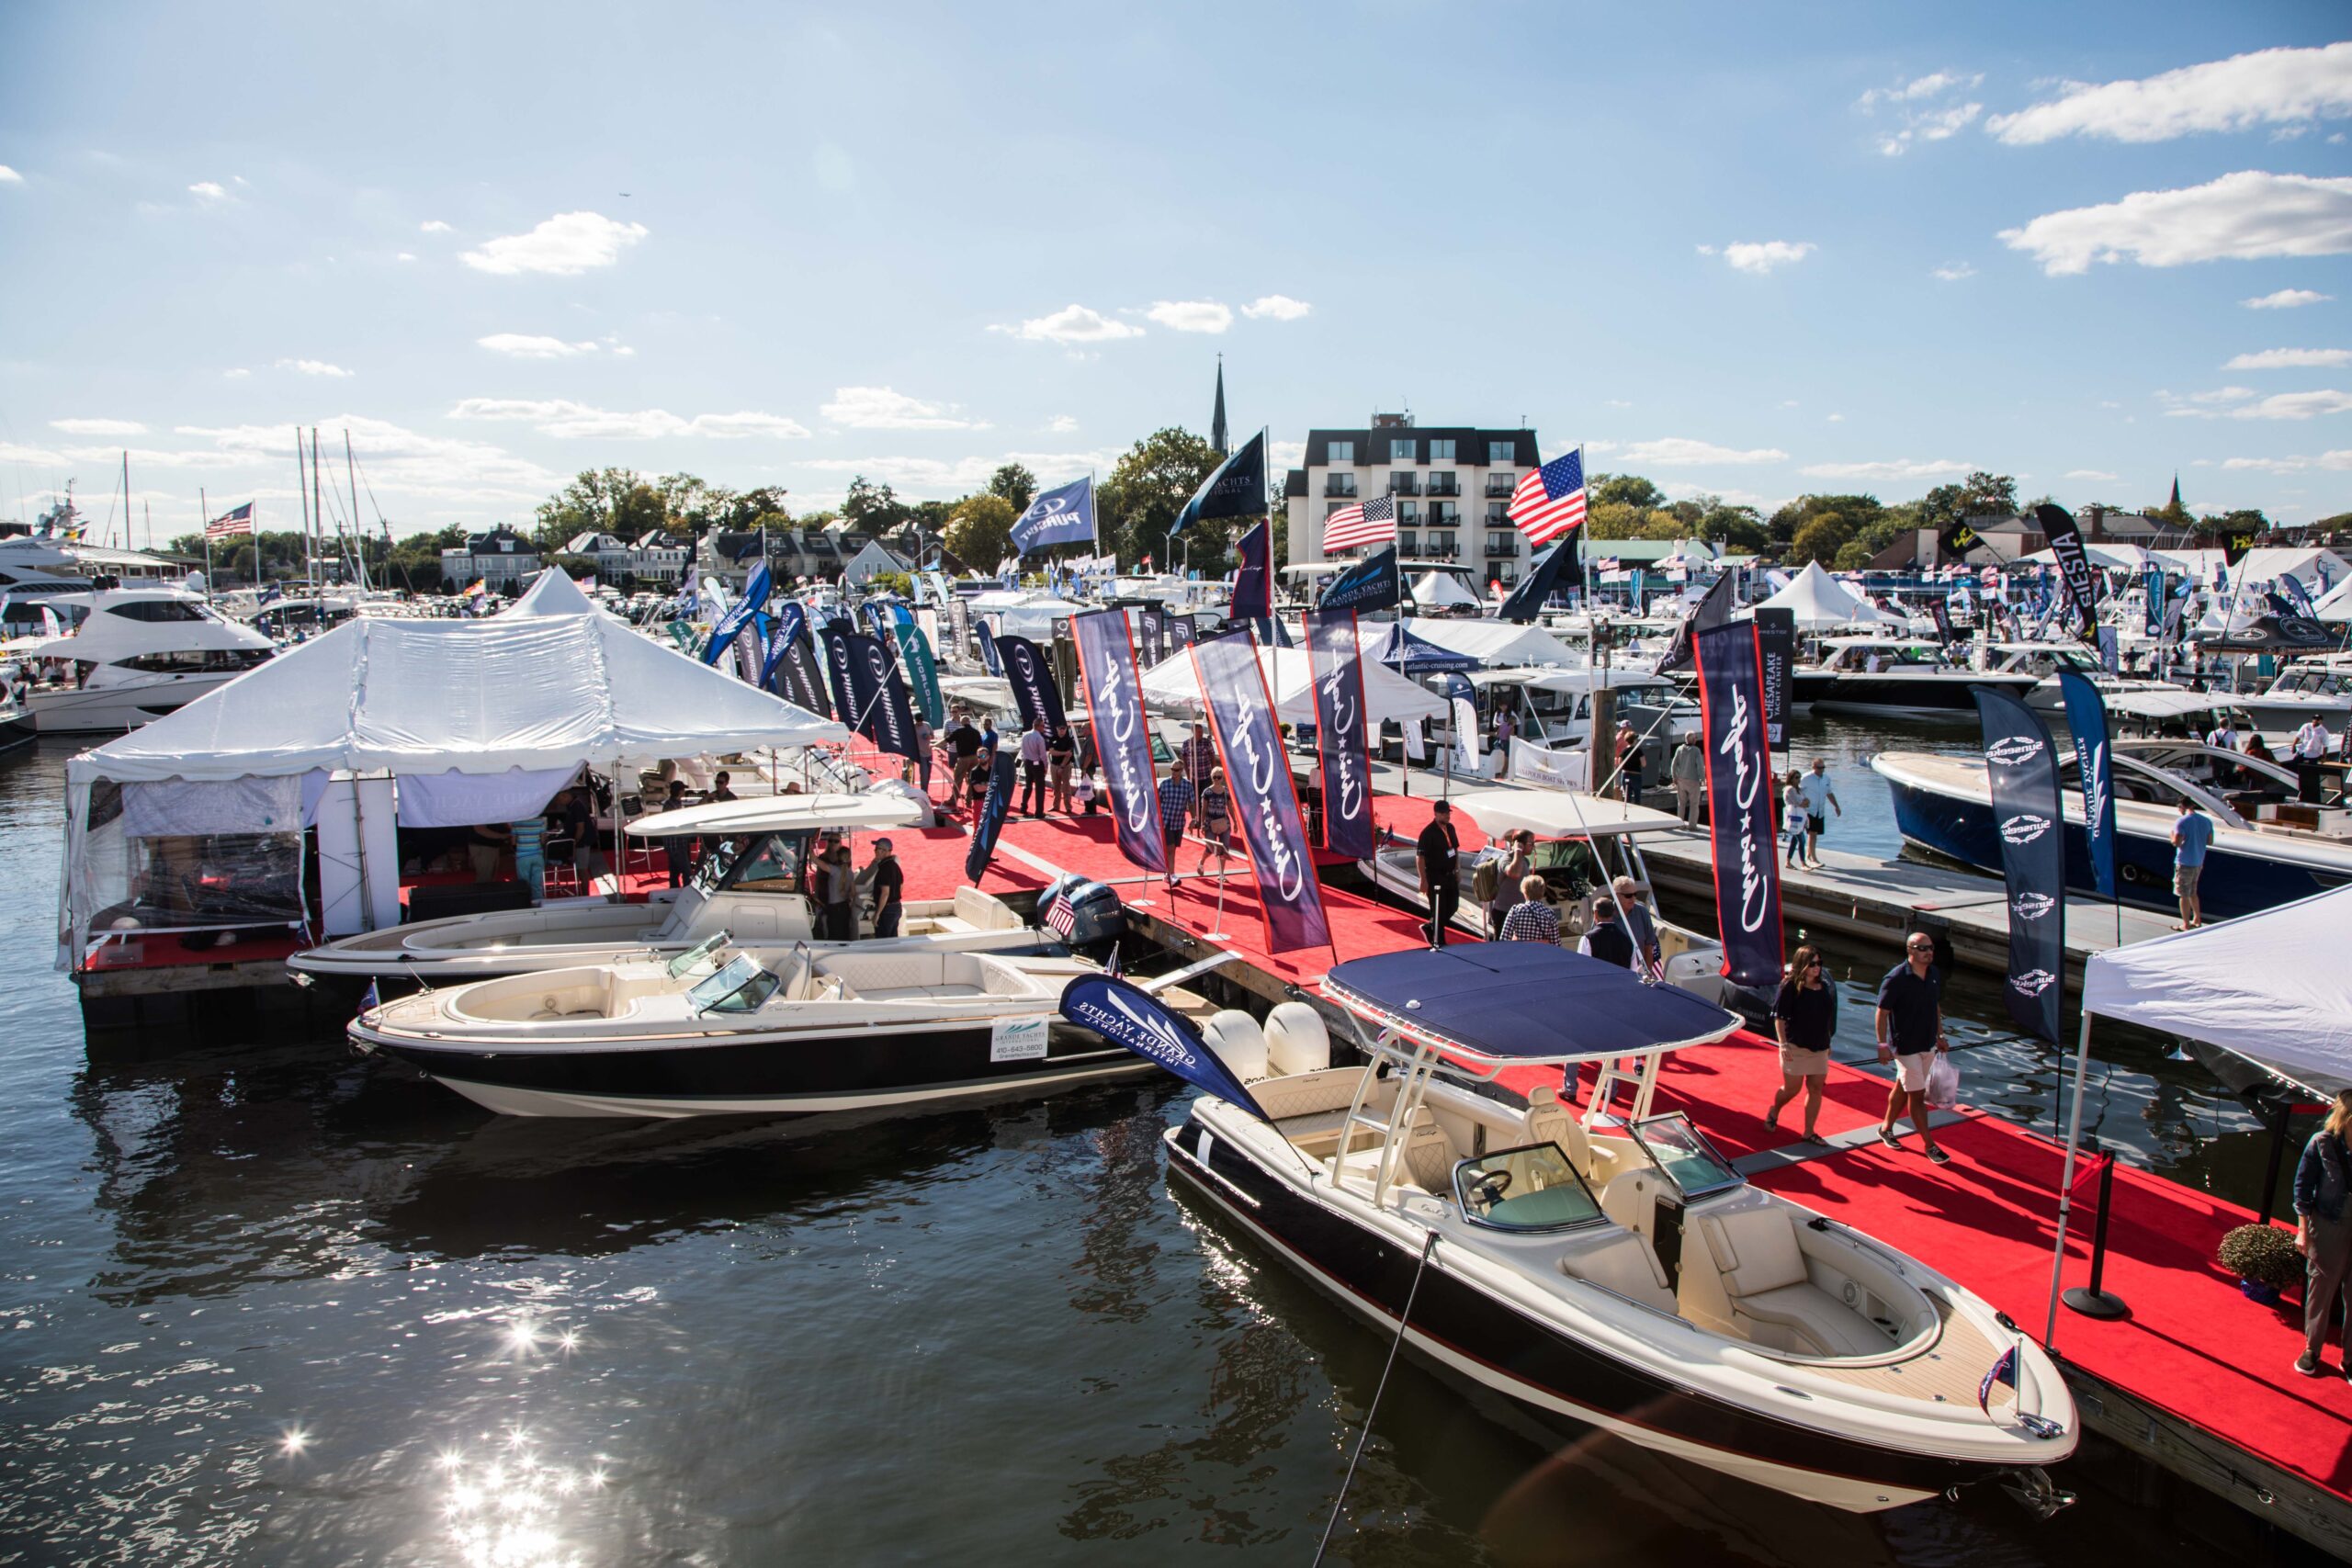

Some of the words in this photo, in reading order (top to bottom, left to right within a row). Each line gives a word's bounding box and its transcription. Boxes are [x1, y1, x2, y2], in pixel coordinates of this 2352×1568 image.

[1215, 476, 1250, 488] ACHTS
[2052, 531, 2092, 608] SIESTA
[1326, 589, 1359, 606] GRANDE
[797, 666, 820, 713] PURSUIT
[1766, 651, 1776, 720] CHESAPEAKE
[881, 687, 902, 749] PURSUIT
